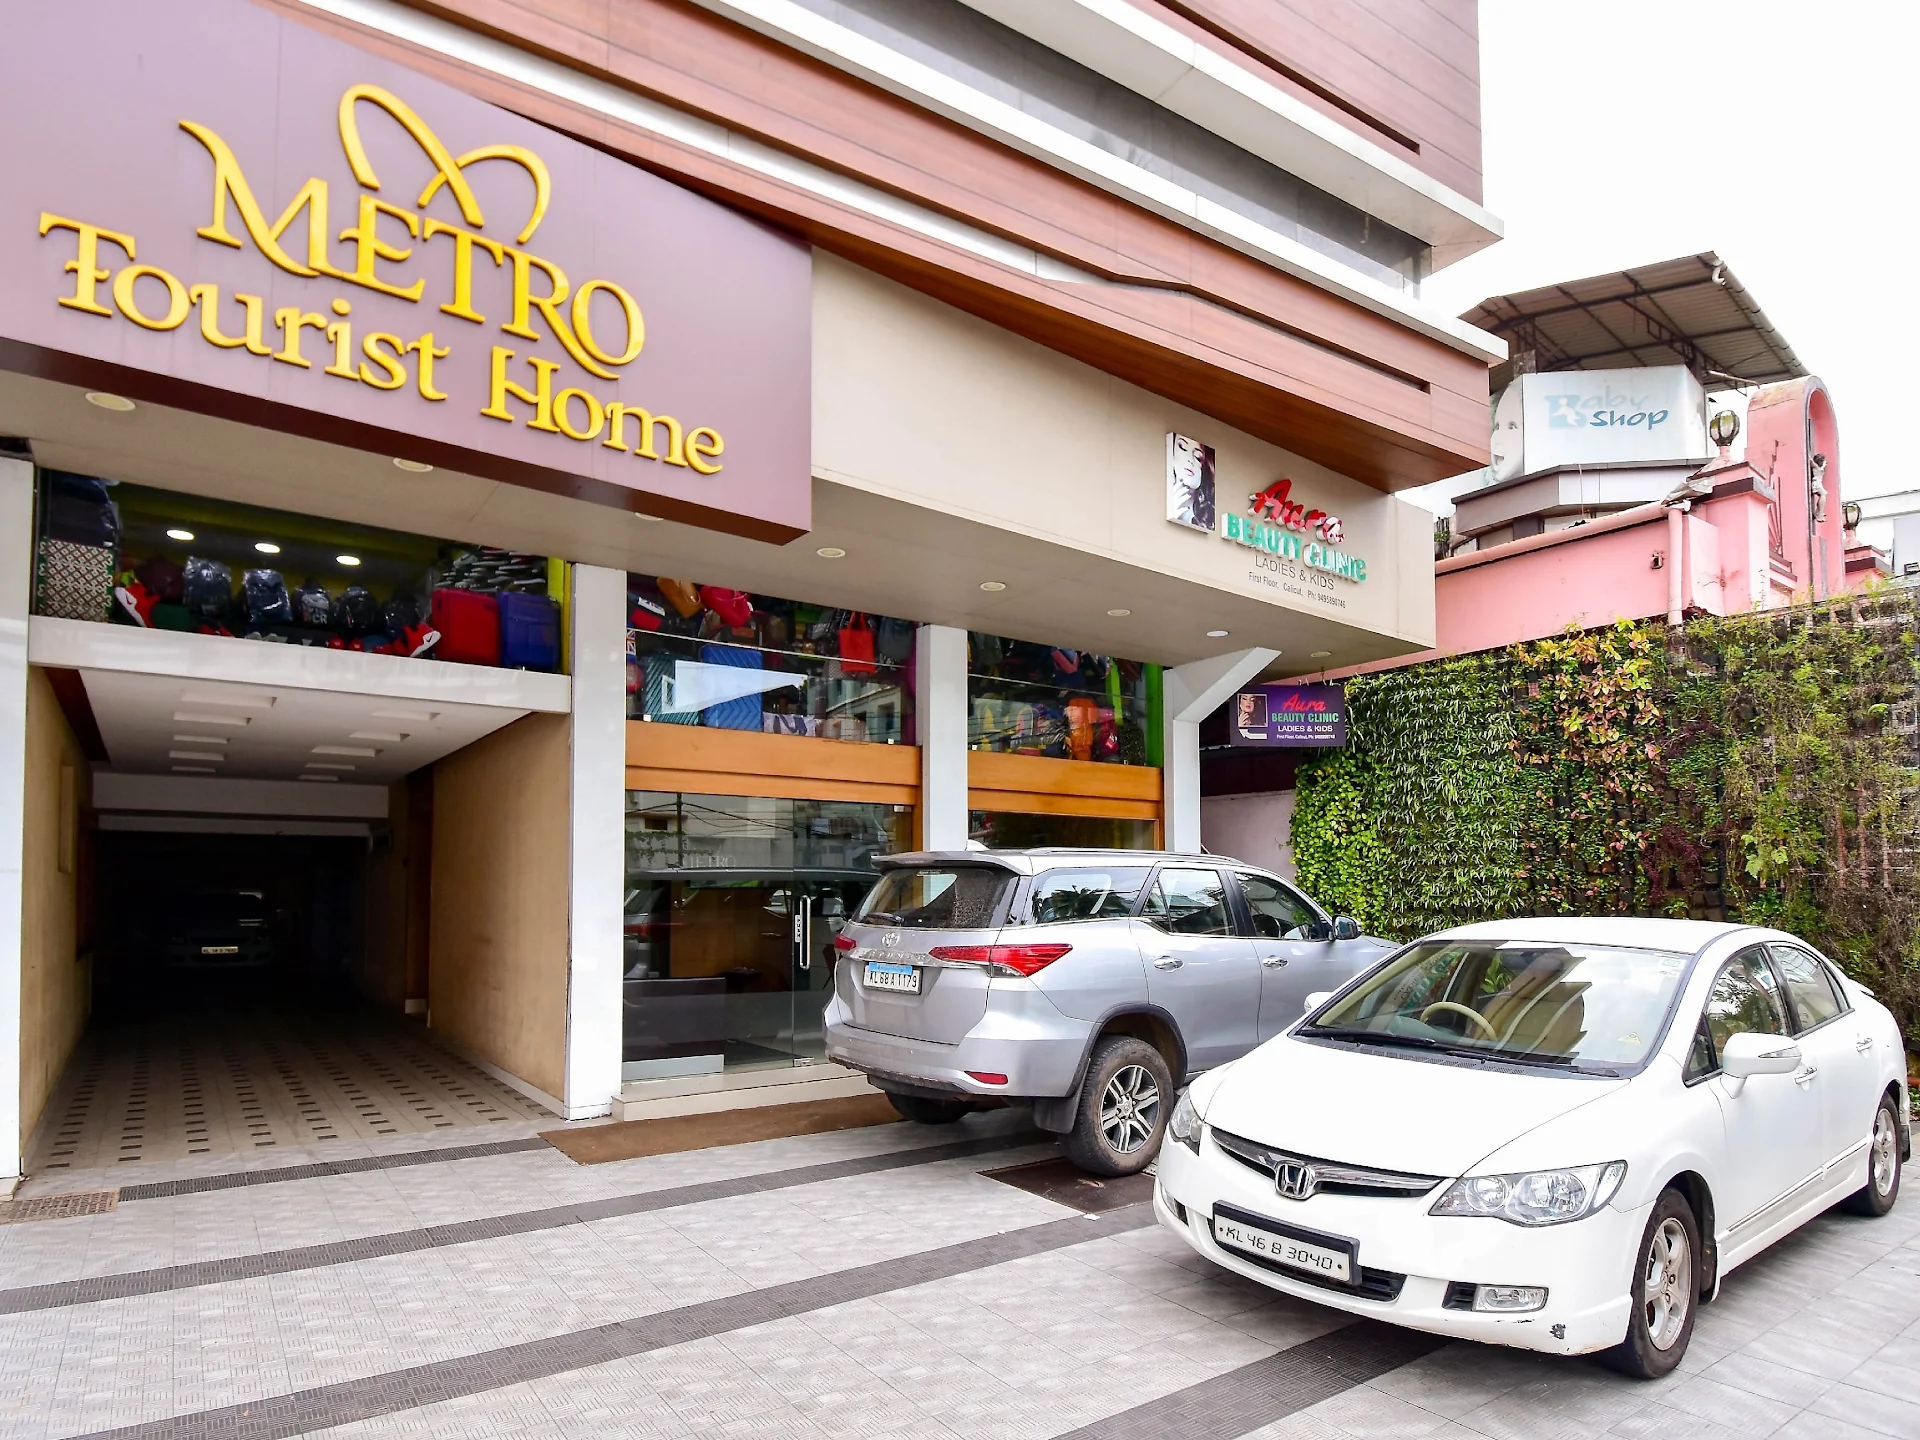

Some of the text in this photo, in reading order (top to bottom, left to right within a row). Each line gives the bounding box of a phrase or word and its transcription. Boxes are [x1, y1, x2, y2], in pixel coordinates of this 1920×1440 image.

[179, 119, 645, 380] METRO
[39, 212, 725, 475] Tourist Home
[1248, 479, 1345, 545] Aura
[1221, 513, 1367, 583] BEAUTY CLINIC
[1248, 571, 1262, 584] First
[1255, 555, 1335, 591] LADIES & KIDS
[1271, 712, 1340, 723] BEAUTY CLINIC
[1283, 693, 1327, 712] Aura
[1226, 1226, 1243, 1243] KL
[1246, 1233, 1266, 1250] 46
[1286, 1246, 1333, 1270] 3040
